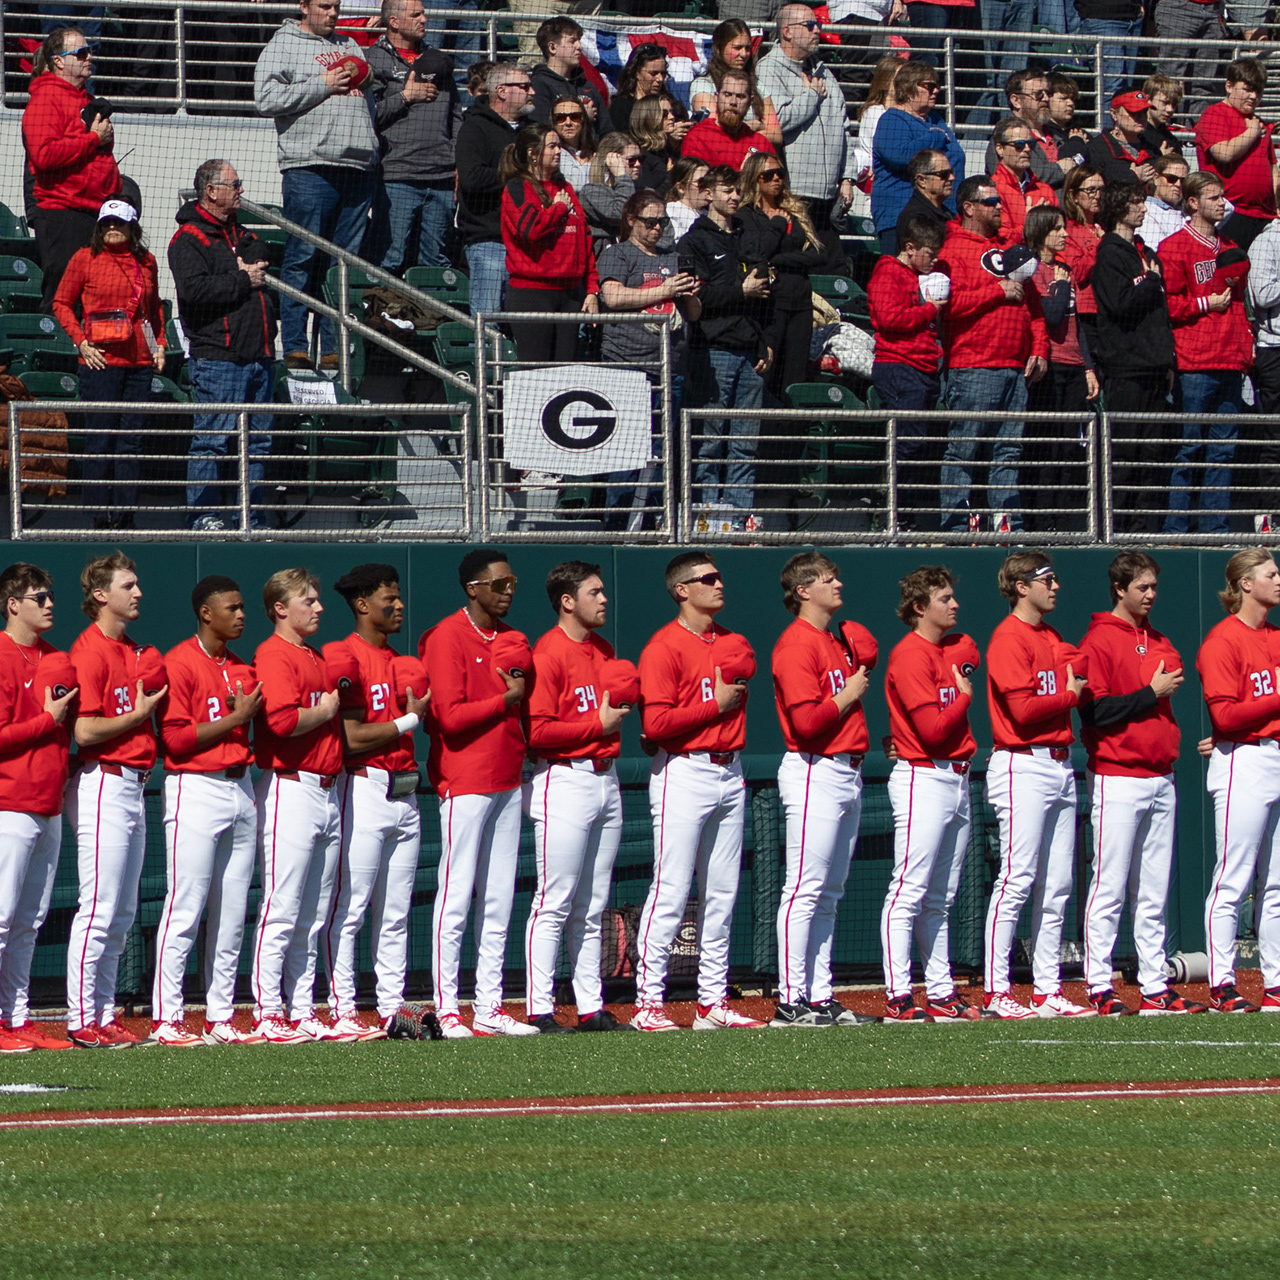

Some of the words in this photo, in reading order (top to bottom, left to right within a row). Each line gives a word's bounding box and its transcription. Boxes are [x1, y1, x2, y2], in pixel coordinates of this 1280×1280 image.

[294, 387, 324, 395] RESERVED
[541, 389, 617, 450] G
[701, 677, 713, 702] 6
[828, 670, 846, 695] 13
[1037, 671, 1056, 695] 38
[1250, 670, 1273, 697] 32
[208, 697, 221, 722] 2
[575, 685, 598, 712] 34
